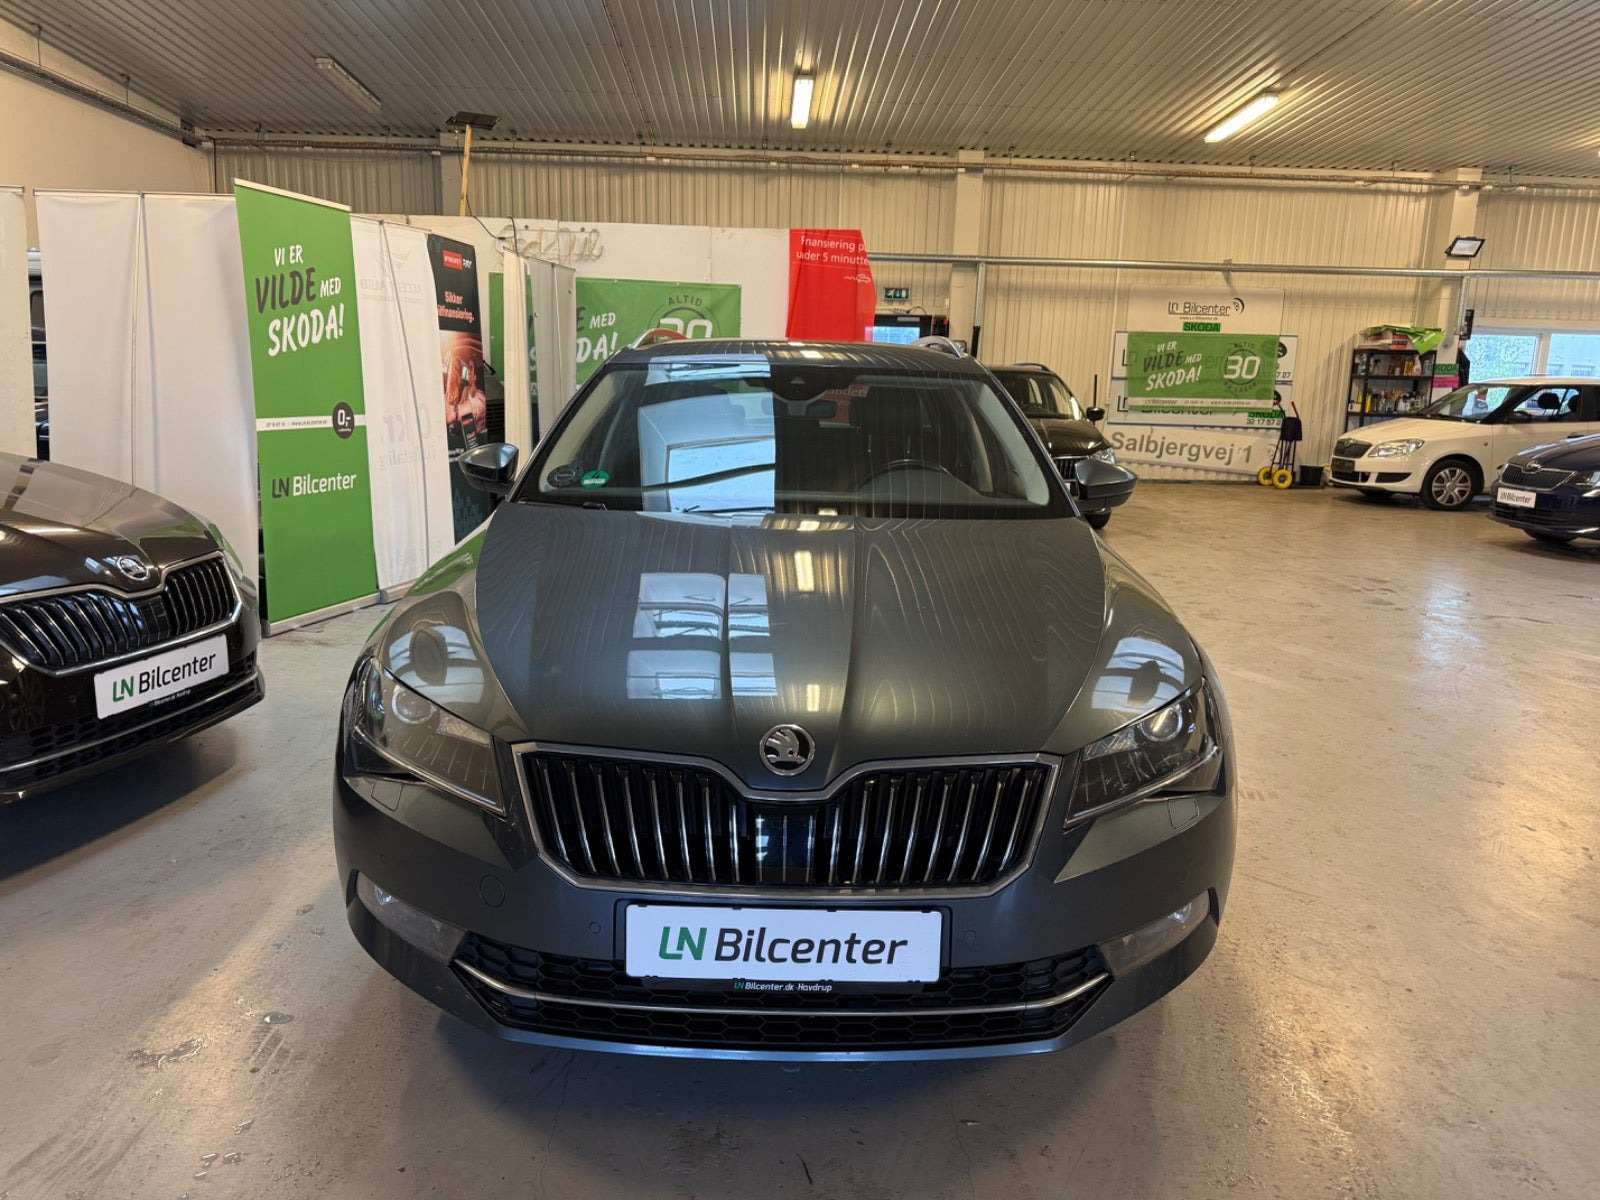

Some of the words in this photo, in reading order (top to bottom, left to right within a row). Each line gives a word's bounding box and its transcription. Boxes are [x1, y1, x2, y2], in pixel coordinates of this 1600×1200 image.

[274, 247, 285, 267] VI
[289, 244, 304, 265] ER
[822, 252, 829, 262] 5
[255, 267, 317, 314] VILDE
[320, 277, 342, 298] MED
[668, 294, 703, 307] ALTID
[1183, 301, 1231, 315] Bilcenter
[268, 302, 345, 357] SKODA!
[589, 312, 616, 329] MED
[1183, 322, 1221, 332] SKODA
[1167, 341, 1177, 350] ER
[1143, 350, 1184, 373] VILDE
[1185, 353, 1202, 364] MED
[1223, 355, 1261, 379] 30
[1145, 365, 1202, 391] SKODA!
[1110, 431, 1235, 465] Salbjergvej
[1243, 445, 1252, 463] 1
[272, 477, 290, 499] LN
[293, 472, 357, 496] Bilcenter
[112, 676, 134, 702] LN
[139, 653, 216, 693] Bilcenter
[658, 926, 708, 961] LN
[714, 927, 909, 965] Bilcenter
[797, 983, 833, 993] Havdrup
